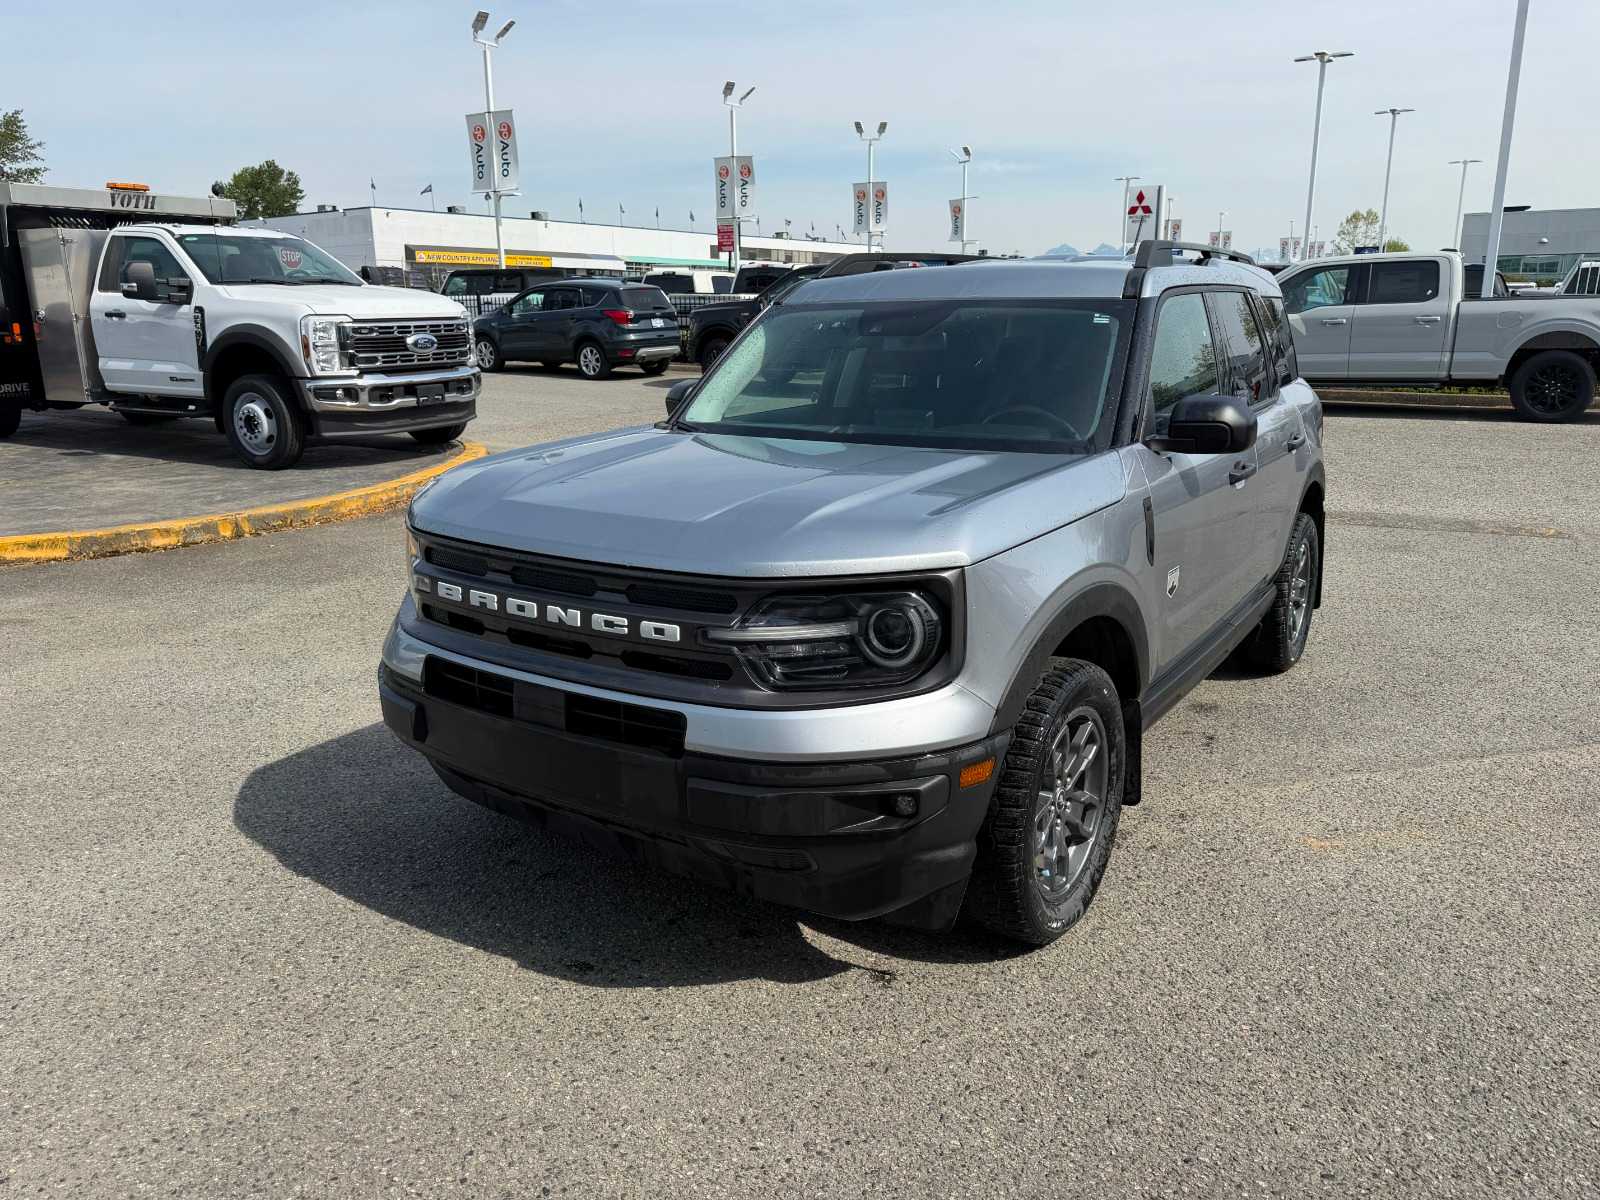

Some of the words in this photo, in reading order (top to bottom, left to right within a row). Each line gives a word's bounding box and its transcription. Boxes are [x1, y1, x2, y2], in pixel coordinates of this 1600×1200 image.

[500, 123, 510, 140] go
[475, 143, 485, 180] Auto
[500, 140, 511, 178] Auto
[110, 192, 157, 209] VOTH
[740, 179, 748, 207] Auto
[281, 250, 301, 262] STOP
[437, 581, 680, 642] BRONCO
